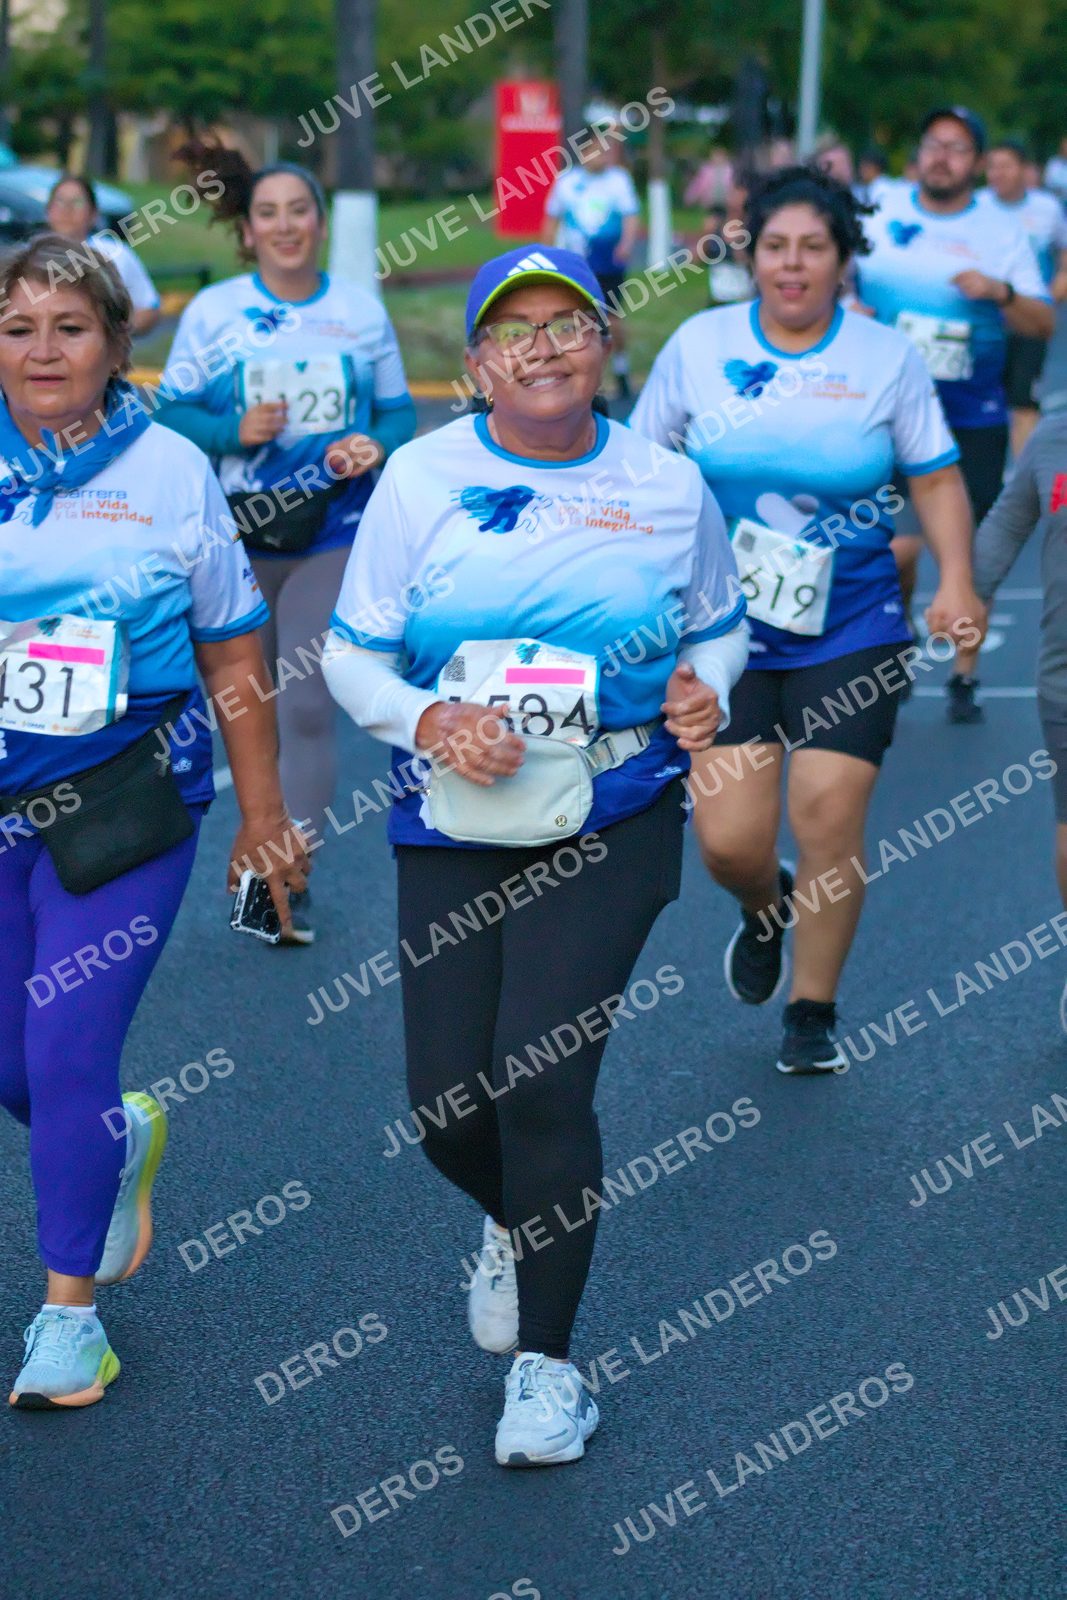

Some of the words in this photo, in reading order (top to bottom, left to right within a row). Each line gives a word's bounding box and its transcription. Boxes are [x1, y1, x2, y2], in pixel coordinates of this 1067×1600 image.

[254, 387, 341, 422] 23
[97, 500, 128, 510] Vida
[83, 510, 152, 525] Integridad
[602, 506, 631, 522] Vida
[449, 693, 594, 736] 84
